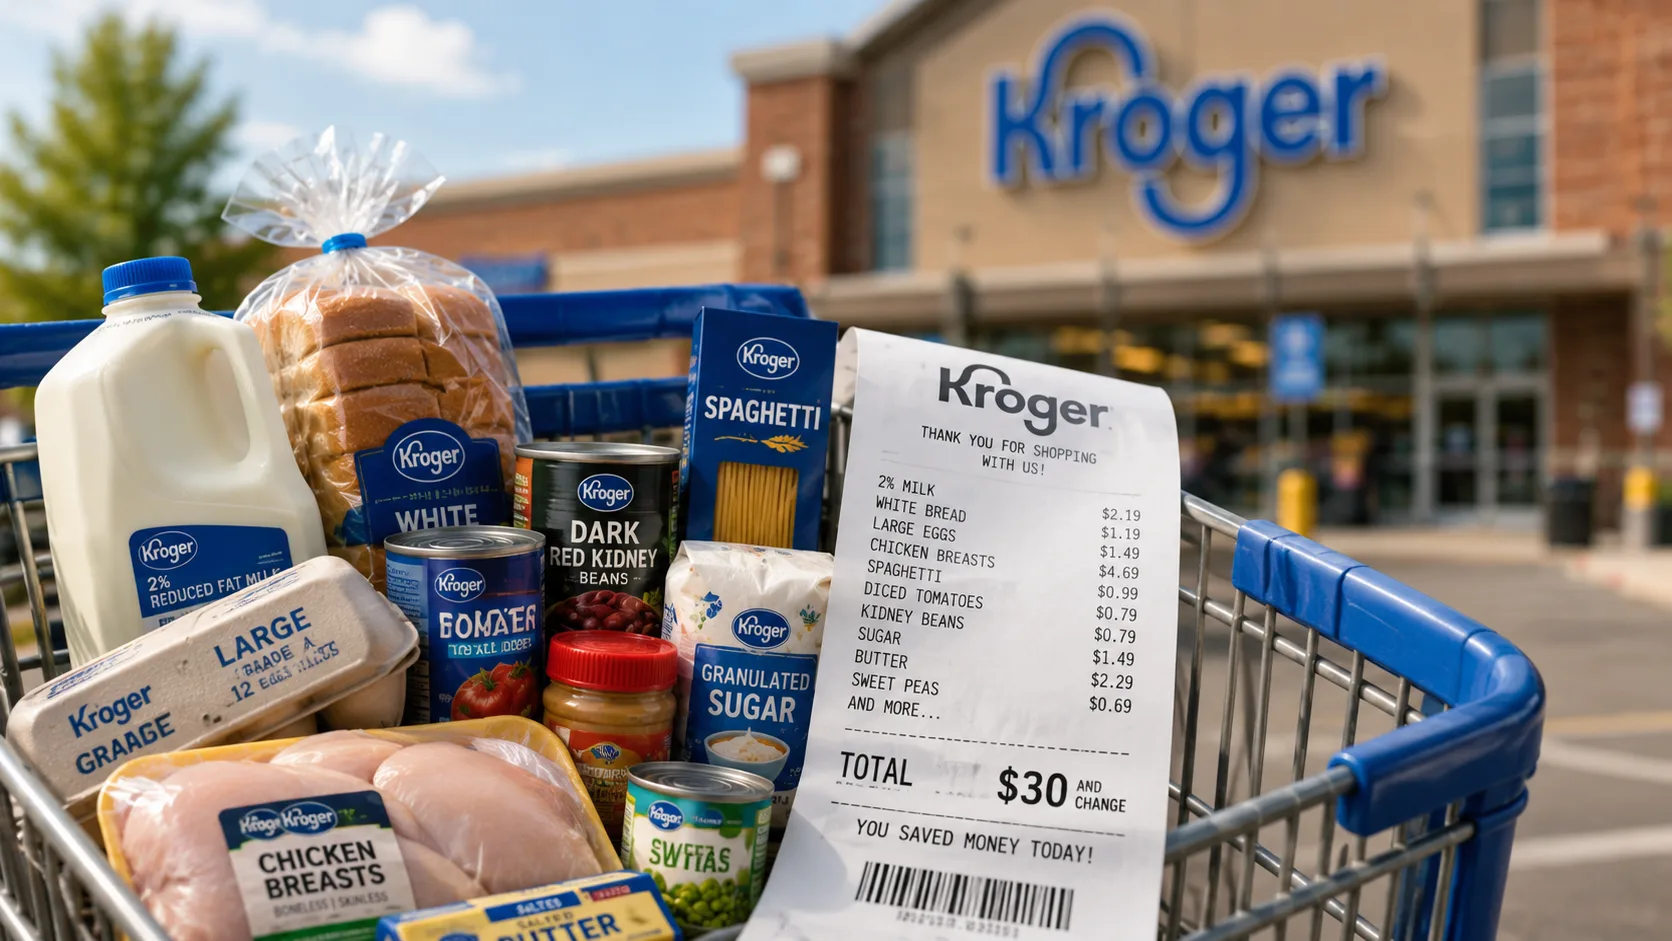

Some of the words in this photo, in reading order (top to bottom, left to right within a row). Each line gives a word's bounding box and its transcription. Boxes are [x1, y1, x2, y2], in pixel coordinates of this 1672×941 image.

[988, 15, 1383, 234] Kroger
[743, 344, 795, 374] Kroger
[704, 395, 821, 430] SPAGHETTI
[938, 364, 1109, 436] Kroger
[399, 440, 460, 475] Kroger
[922, 426, 961, 444] THANK
[969, 434, 994, 449] YOU
[1001, 440, 1026, 455] FOR
[1033, 445, 1097, 465] SHOPPING
[982, 455, 1015, 472] WITH
[1022, 461, 1046, 476] US!
[583, 480, 630, 507] Kroger
[878, 475, 895, 490] 2%
[903, 479, 935, 497] MILK
[395, 504, 480, 533] WHITE
[876, 495, 917, 515] WHITE
[925, 505, 967, 523] BREAD
[1102, 507, 1141, 522] $2.19
[571, 520, 640, 545] DARK
[873, 516, 915, 536] LARGE
[923, 525, 957, 542] EGGS
[1101, 526, 1141, 541] $1.19
[141, 538, 194, 564] Kroger
[550, 546, 586, 567] RED
[592, 548, 658, 568] KIDNEY
[870, 538, 929, 560] CHICKEN
[937, 549, 995, 569] BREASTS
[1100, 546, 1140, 560] $1.49
[147, 575, 171, 592] 2%
[580, 572, 628, 585] BEANS
[867, 559, 942, 583] SPAGHETTI
[1098, 565, 1140, 580] $4.69
[150, 582, 214, 609] REDUCED
[217, 576, 242, 593] FAT
[438, 573, 483, 598] Kroger
[864, 581, 907, 601] DICED
[916, 588, 984, 610] TOMATOES
[1097, 585, 1139, 600] $0.99
[860, 604, 914, 624] KIDNEY
[922, 612, 965, 630] BEANS
[1096, 606, 1137, 622] $0.79
[214, 607, 312, 668] LARGE
[737, 616, 787, 643] Kroger
[857, 627, 901, 646] SUGAR
[1094, 627, 1136, 644] $0.79
[854, 649, 908, 670] BUTTER
[1092, 650, 1135, 667] $1.49
[701, 663, 811, 691] GRANULATED
[851, 672, 895, 691] SWEET
[904, 679, 939, 696] PEAS
[1090, 672, 1134, 690] $2.29
[231, 681, 255, 702] 12
[68, 685, 152, 738] Kroger
[708, 688, 796, 723] SUGAR
[847, 696, 875, 712] AND
[883, 700, 941, 720] MORE...
[1089, 696, 1132, 714] $0.69
[840, 751, 913, 786] TOTAL
[997, 766, 1068, 807] $30
[1076, 780, 1102, 793] AND
[1075, 796, 1126, 813] CHANGE
[281, 808, 333, 830] Kroger
[856, 819, 889, 838] YOU
[899, 825, 954, 846] SAVED
[964, 833, 1020, 855] MONEY
[1031, 840, 1093, 864] TODAY!
[258, 840, 377, 874] CHICKEN
[265, 864, 386, 900] BREASTS
[497, 913, 622, 941] TTER
